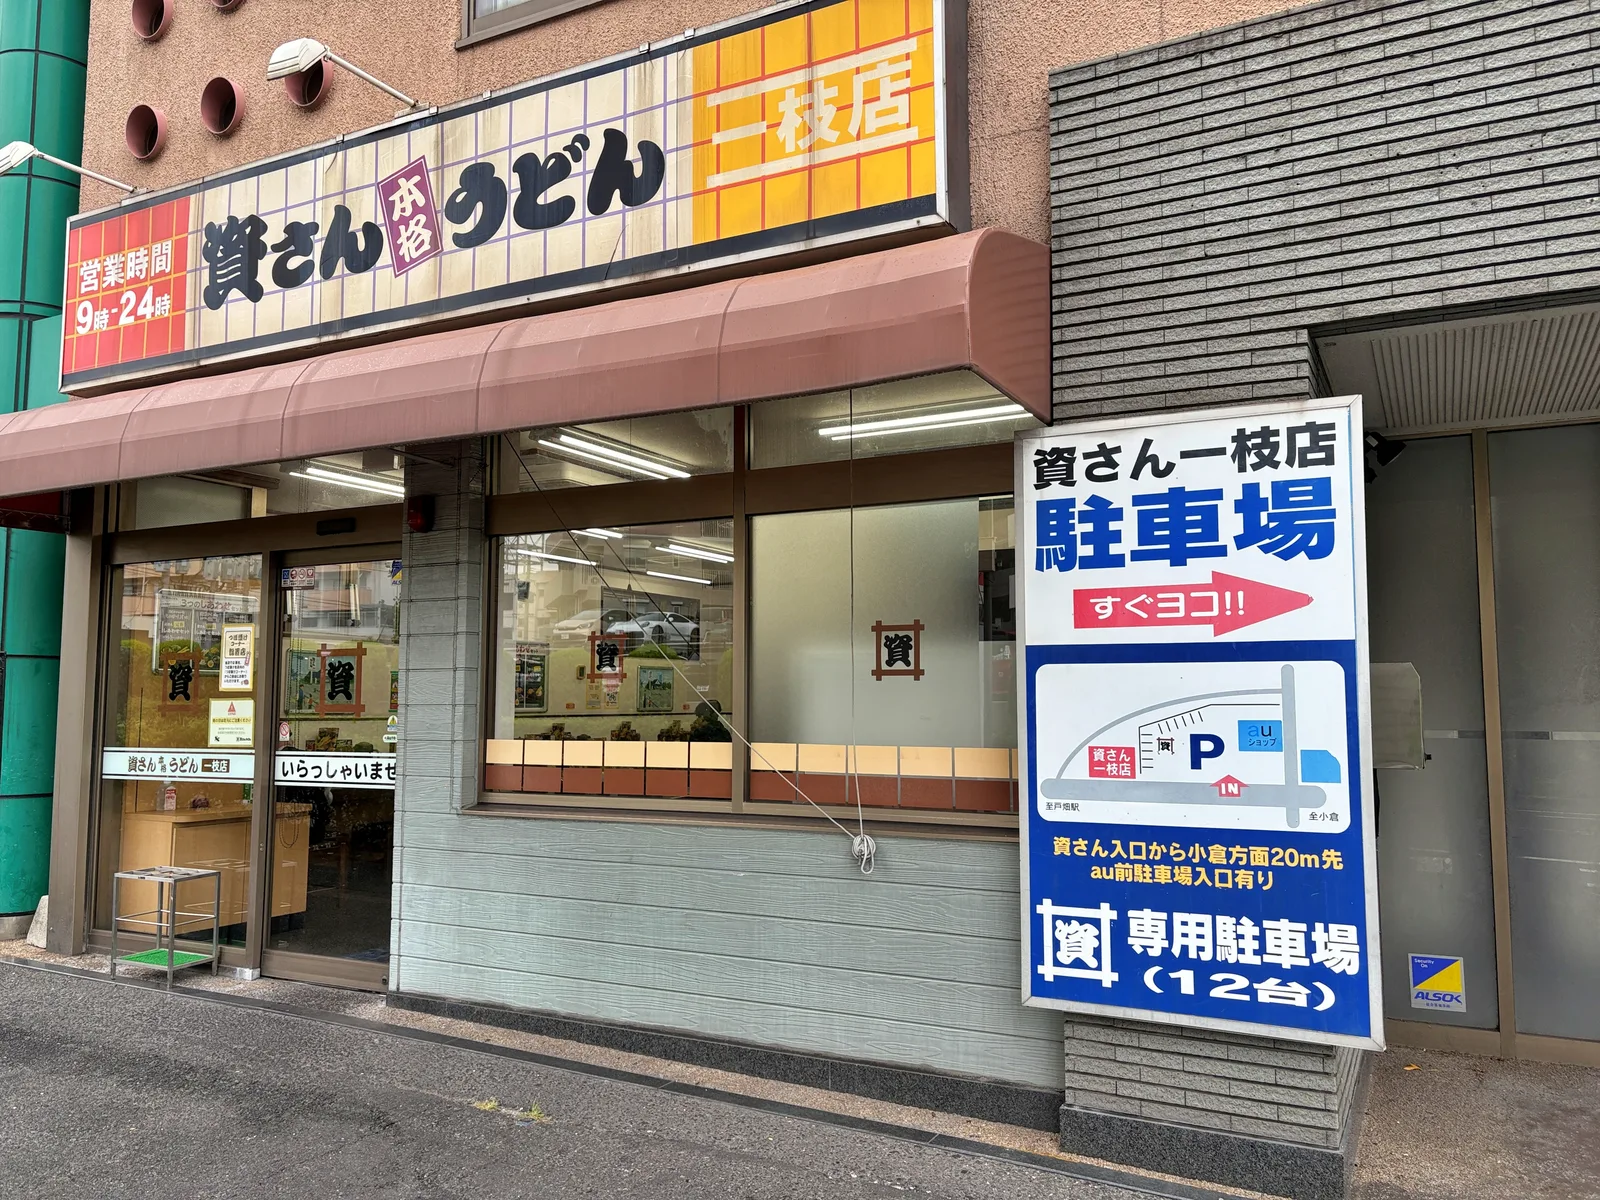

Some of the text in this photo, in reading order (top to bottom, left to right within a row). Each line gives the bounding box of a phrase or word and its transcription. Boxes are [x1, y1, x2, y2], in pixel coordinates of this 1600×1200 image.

[711, 59, 912, 154] 一枝店
[202, 127, 666, 310] 資さん 本格 うどん
[80, 240, 172, 294] 営業時間
[1033, 421, 1336, 490] 資さん一枝店
[1035, 476, 1336, 572] 駐車場
[1089, 590, 1245, 619] すぐヨコ!!
[596, 641, 619, 671] 資
[883, 633, 913, 668] 資
[168, 663, 193, 701] 資
[327, 660, 355, 701] 資
[1248, 725, 1272, 737] au
[1248, 738, 1277, 747] ショップ
[128, 755, 156, 773] 資さん
[169, 756, 199, 774] うどん
[203, 759, 228, 772] 一枝店
[1093, 748, 1131, 762] 資さん
[1190, 733, 1225, 770] P
[281, 759, 396, 780] いらっしゃいませ
[1093, 762, 1131, 776] 一枝店
[1220, 783, 1239, 795] IN
[1045, 801, 1081, 812] 至戸畑駅
[1053, 837, 1344, 870] 資さん入口から小倉方面20m先
[1090, 862, 1274, 891] au前駐車場入口有り
[1055, 919, 1100, 968] 資
[1128, 908, 1360, 976] 専用駐車場
[1414, 991, 1463, 1005] ALSOK
